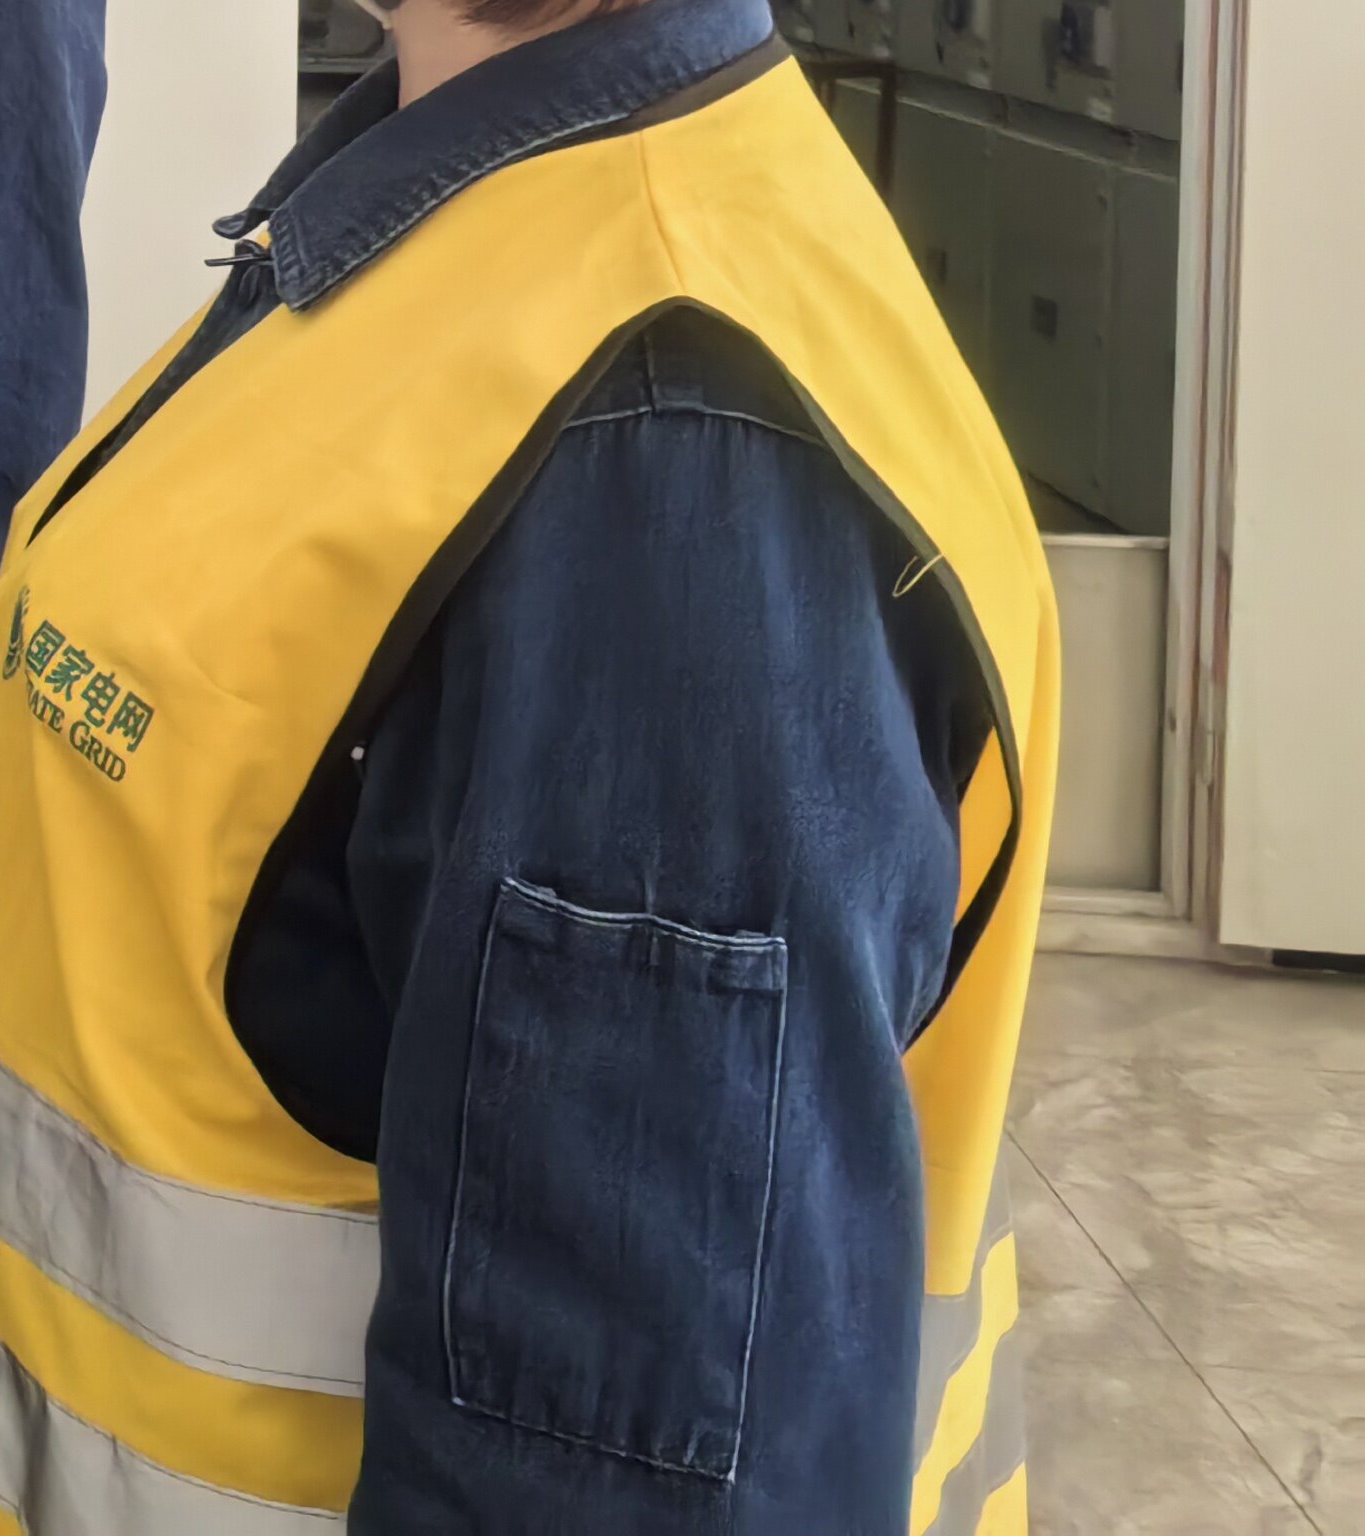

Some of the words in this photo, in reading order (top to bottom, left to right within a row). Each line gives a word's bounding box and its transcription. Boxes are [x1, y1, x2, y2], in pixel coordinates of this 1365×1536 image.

[25, 619, 155, 752] 国家电网
[69, 720, 127, 782] GRID
